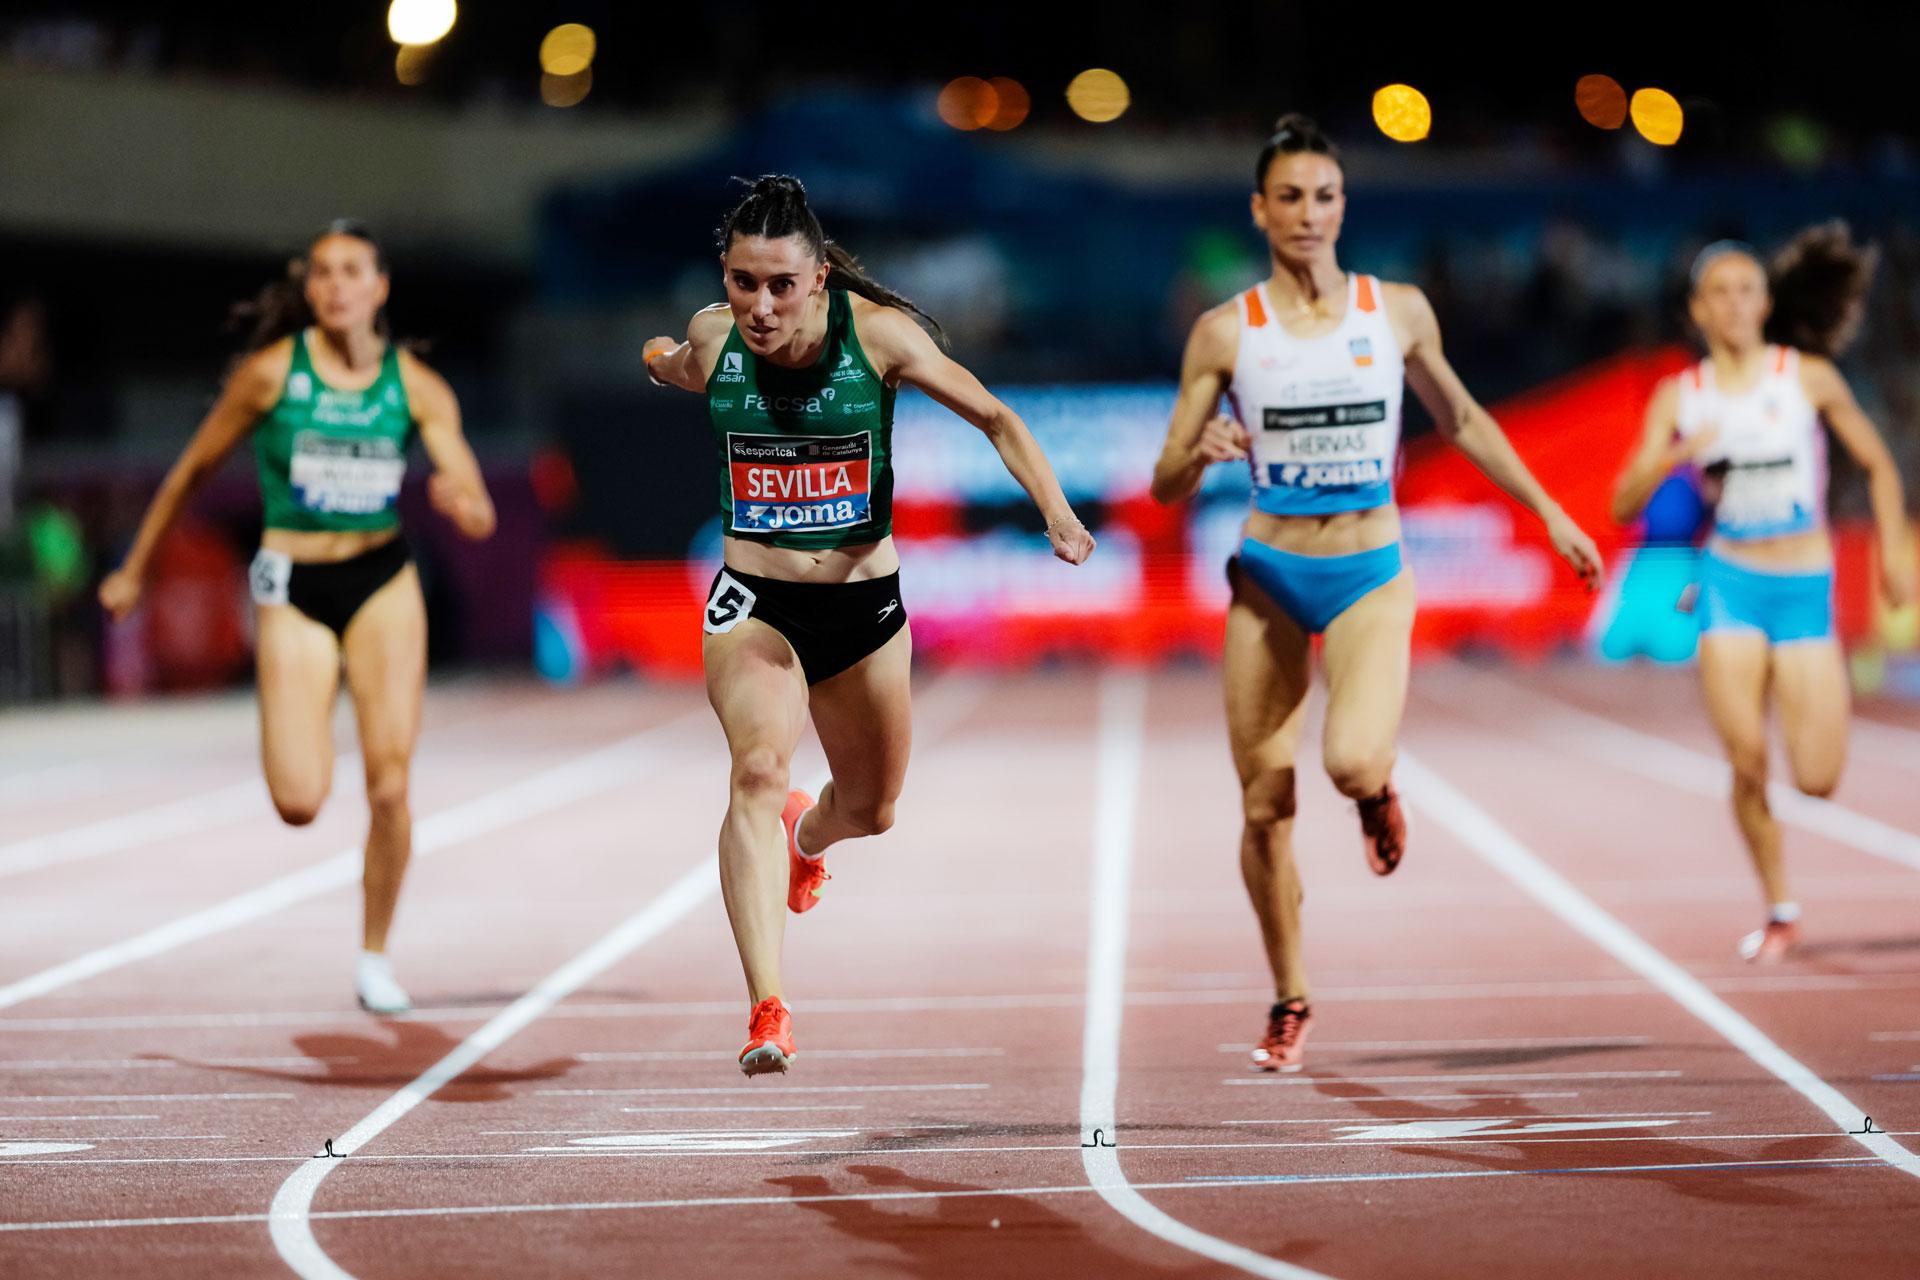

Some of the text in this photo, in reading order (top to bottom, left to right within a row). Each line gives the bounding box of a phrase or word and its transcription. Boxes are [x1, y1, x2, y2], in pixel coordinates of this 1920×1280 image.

[744, 394, 823, 413] Facsa
[747, 466, 852, 498] SEVILLA
[708, 585, 746, 626] 5
